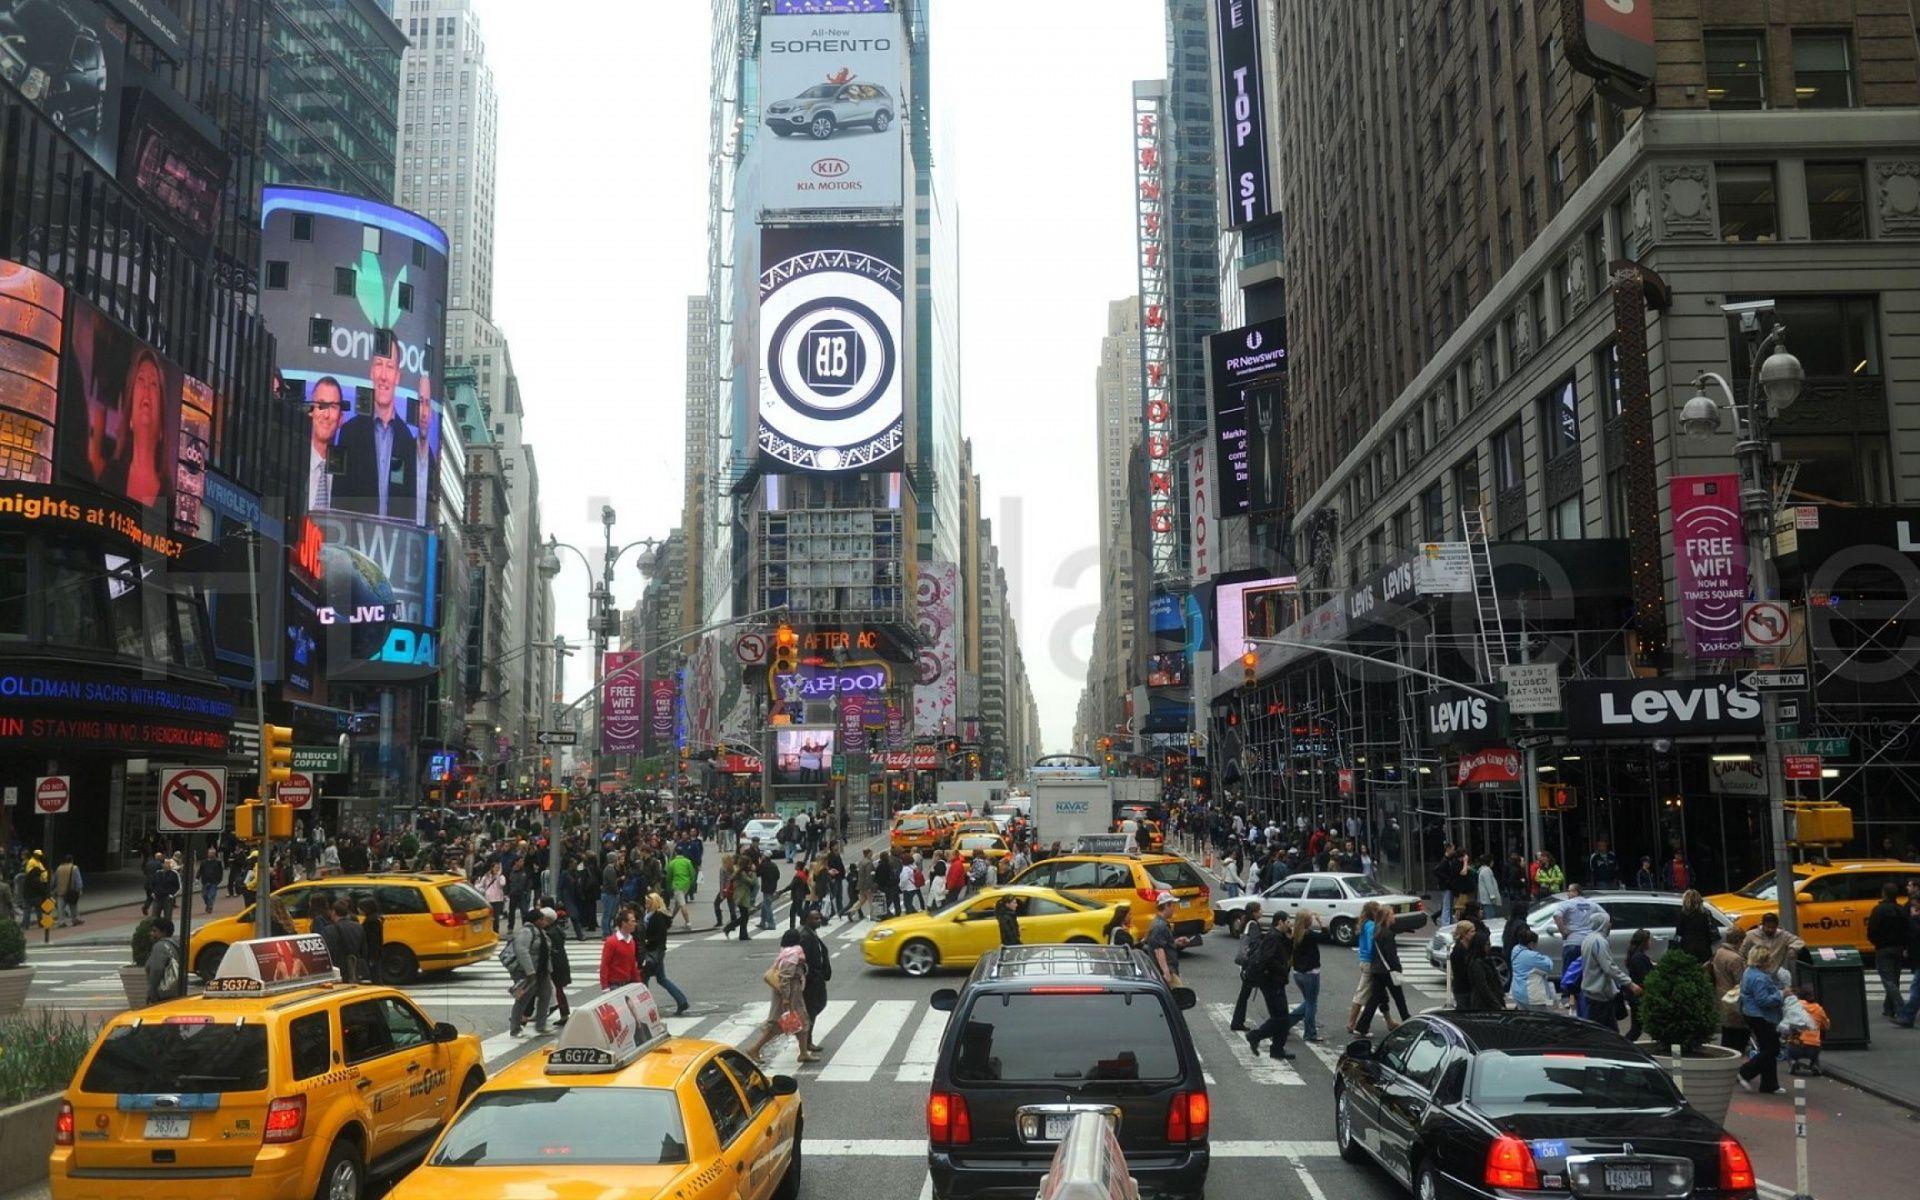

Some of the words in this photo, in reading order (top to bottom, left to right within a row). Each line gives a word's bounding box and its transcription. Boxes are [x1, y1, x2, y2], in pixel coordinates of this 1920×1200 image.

[770, 39, 891, 53] SORENTO
[1233, 66, 1251, 147] TOP
[818, 163, 844, 173] KIA
[797, 182, 814, 190] KIA
[818, 181, 862, 190] MOTORS
[1240, 172, 1256, 222] ST
[1240, 348, 1286, 368] Newswire
[87, 508, 104, 526] at
[1194, 447, 1207, 577] RICOH
[1686, 537, 1734, 557] FREE
[1690, 557, 1732, 578] WIFI
[1698, 580, 1718, 588] NOW
[1720, 579, 1728, 587] IN
[1684, 591, 1710, 600] TIMES
[1711, 590, 1744, 600] SQUARE
[350, 605, 385, 623] JVC
[804, 632, 850, 649] AFTER
[776, 672, 885, 694] YAHOO!
[1512, 678, 1548, 687] CLOSED
[1749, 676, 1769, 686] ONE
[1780, 675, 1801, 684] WAY
[85, 683, 128, 703] SACHS
[610, 686, 636, 697] FREE
[612, 698, 634, 708] WIFI
[1815, 741, 1835, 753] 44
[294, 752, 338, 760] ARBUCKS
[1056, 803, 1089, 811] NAVAC
[222, 980, 248, 991] 5G37
[565, 1050, 596, 1062] 6G72
[1543, 1146, 1559, 1157] 061
